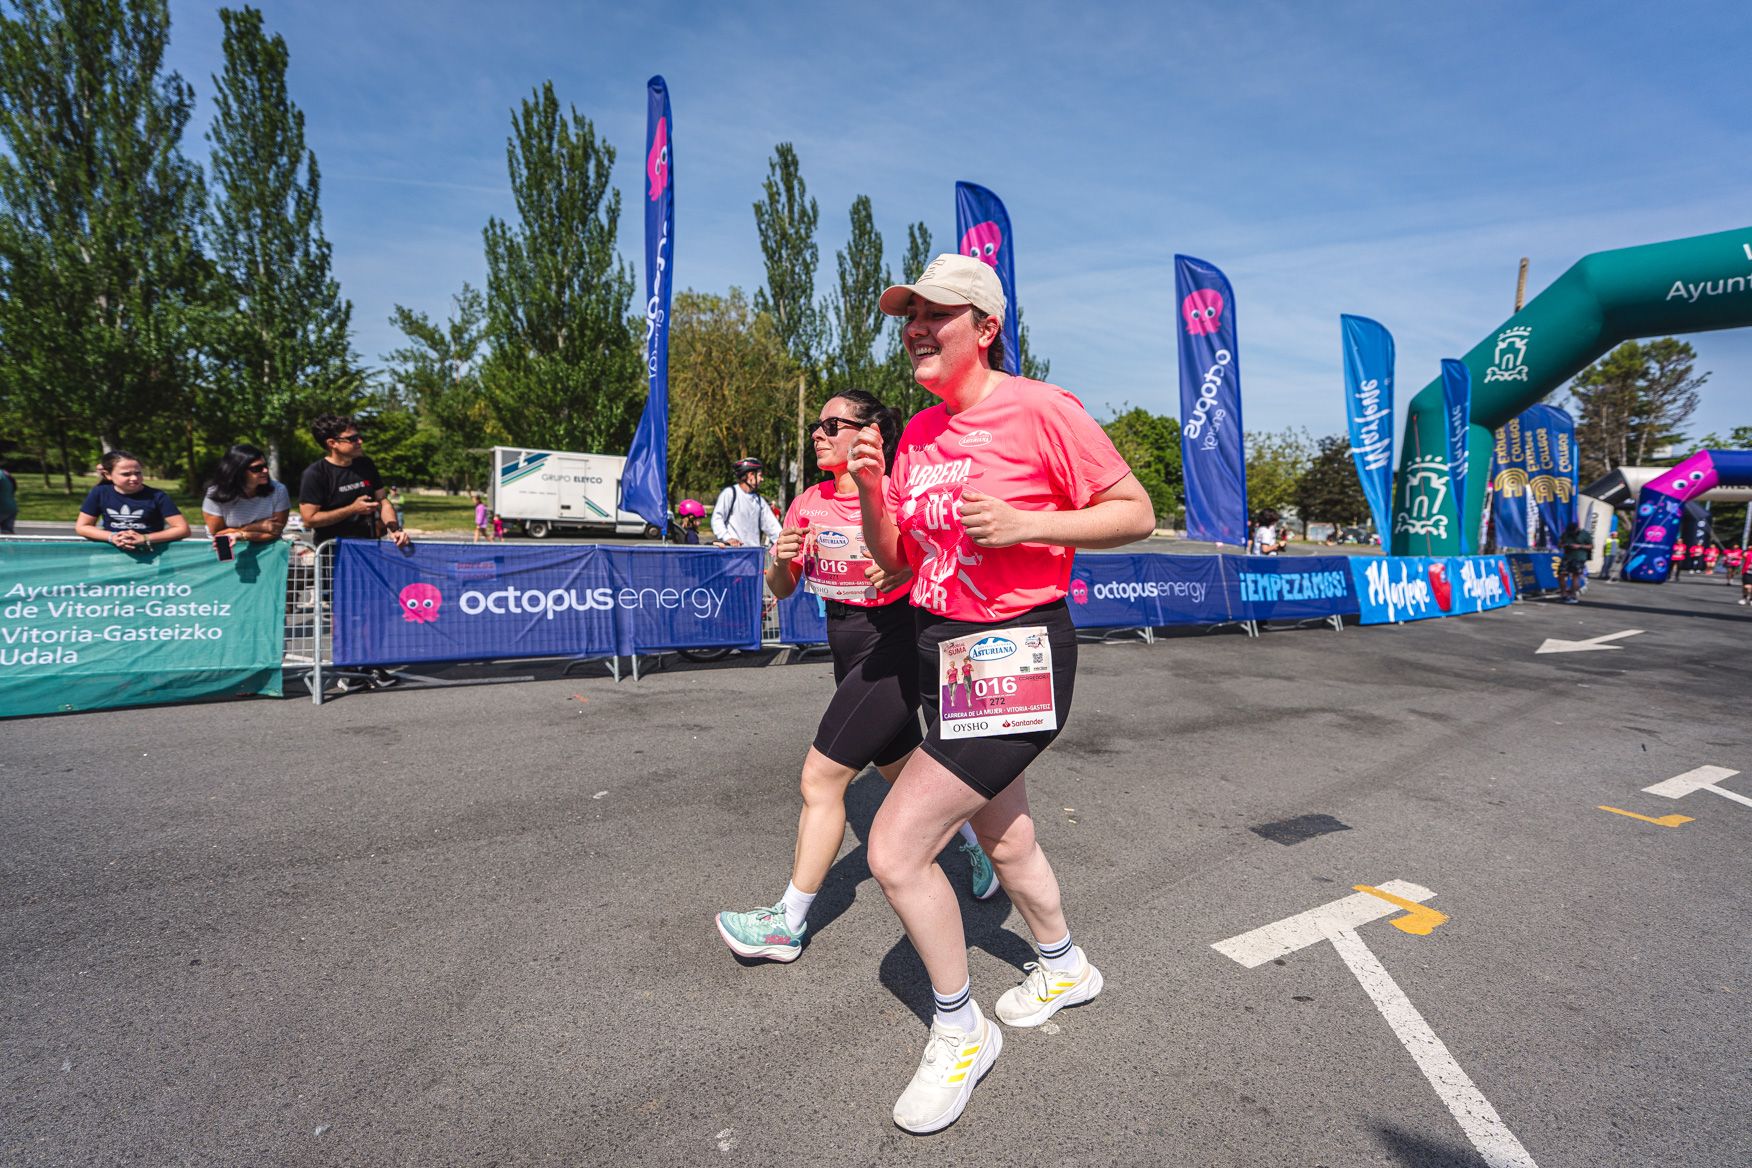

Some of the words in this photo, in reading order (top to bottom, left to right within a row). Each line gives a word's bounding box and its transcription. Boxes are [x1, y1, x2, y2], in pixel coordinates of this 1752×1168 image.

[541, 474, 571, 482] GRUPO
[904, 458, 971, 489] ARRERA
[799, 508, 828, 516] OYSHO
[820, 560, 848, 573] 016
[4, 581, 192, 601] Ayuntamiento
[1094, 580, 1158, 602] octopus
[1158, 581, 1206, 603] energy
[1240, 570, 1347, 601] ¡EMPEZAMOS!
[4, 602, 39, 618] de
[48, 600, 231, 618] Vitoria-Gasteiz
[459, 586, 614, 619] octopus
[618, 587, 727, 618] energy
[1, 624, 223, 643] Vitoria-Gasteizko
[0, 647, 78, 665] Udala
[949, 647, 967, 656] SUMA
[972, 646, 1014, 658] ASTURIANA
[974, 676, 1018, 697] 016
[990, 697, 1006, 706] 272
[944, 711, 968, 719] CARRERA
[1006, 703, 1051, 714] VITORIA-GASTEIZ
[953, 721, 989, 733] OYSHO
[1011, 718, 1044, 728] Santander
